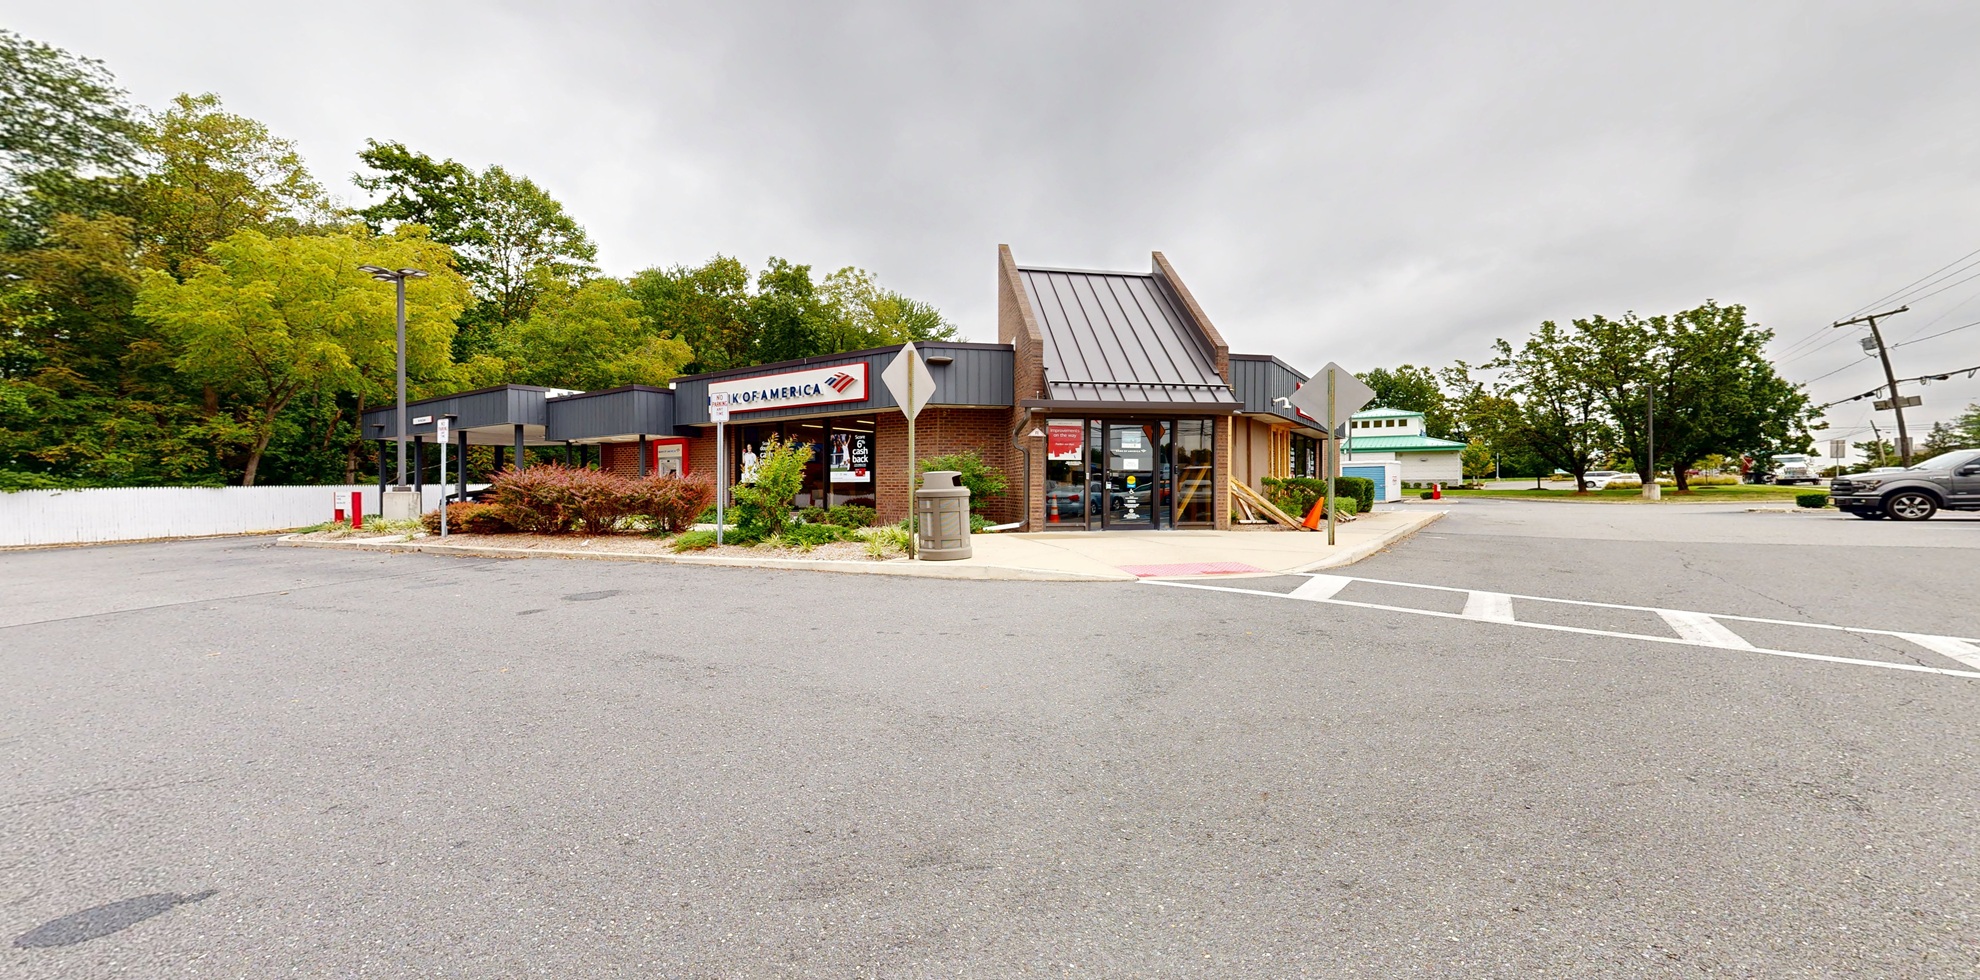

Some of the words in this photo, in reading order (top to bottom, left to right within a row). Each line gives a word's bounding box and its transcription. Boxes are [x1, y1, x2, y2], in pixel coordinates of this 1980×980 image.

[743, 390, 757, 403] OF
[760, 383, 822, 401] AMERICA
[852, 446, 868, 455] cash
[852, 455, 869, 463] back
